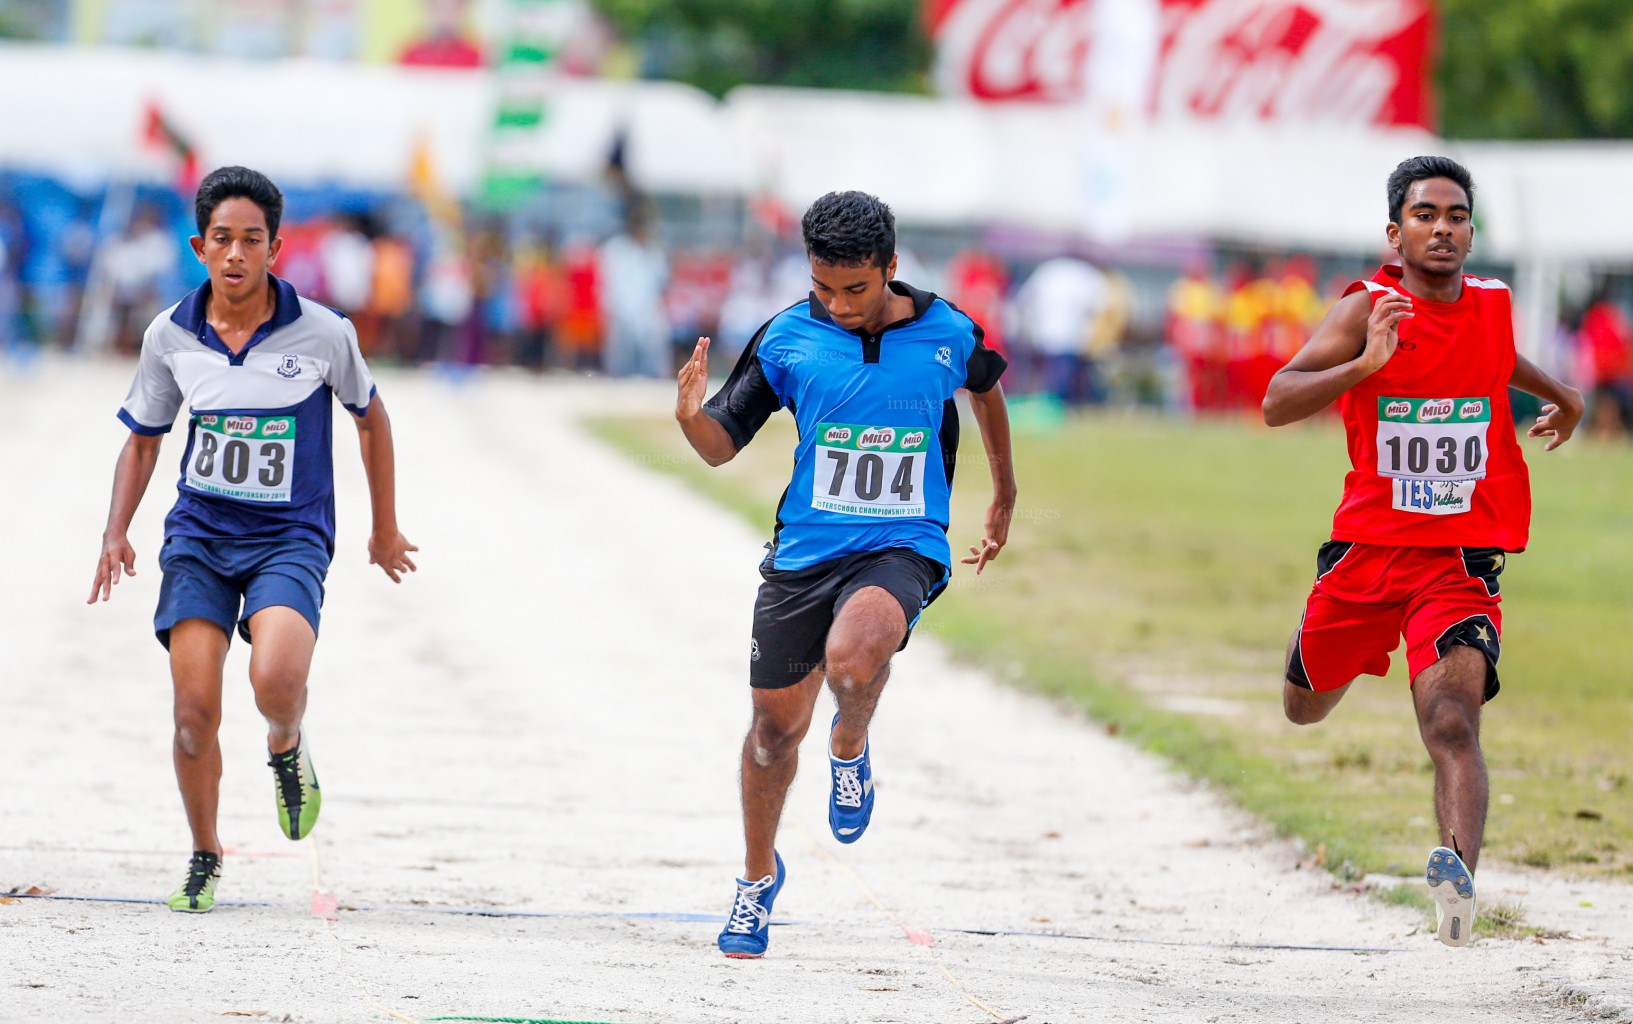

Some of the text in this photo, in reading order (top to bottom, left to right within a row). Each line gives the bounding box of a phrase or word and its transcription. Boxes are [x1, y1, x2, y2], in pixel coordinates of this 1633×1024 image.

[227, 420, 253, 431] MILO
[1388, 404, 1481, 417] MILO MILO MILO
[828, 431, 849, 439] MILO
[861, 433, 892, 444] MILO
[904, 436, 922, 445] MILO
[195, 432, 286, 487] 803
[1386, 435, 1482, 474] 1030
[827, 450, 914, 502] 704
[1399, 479, 1433, 509] TES
